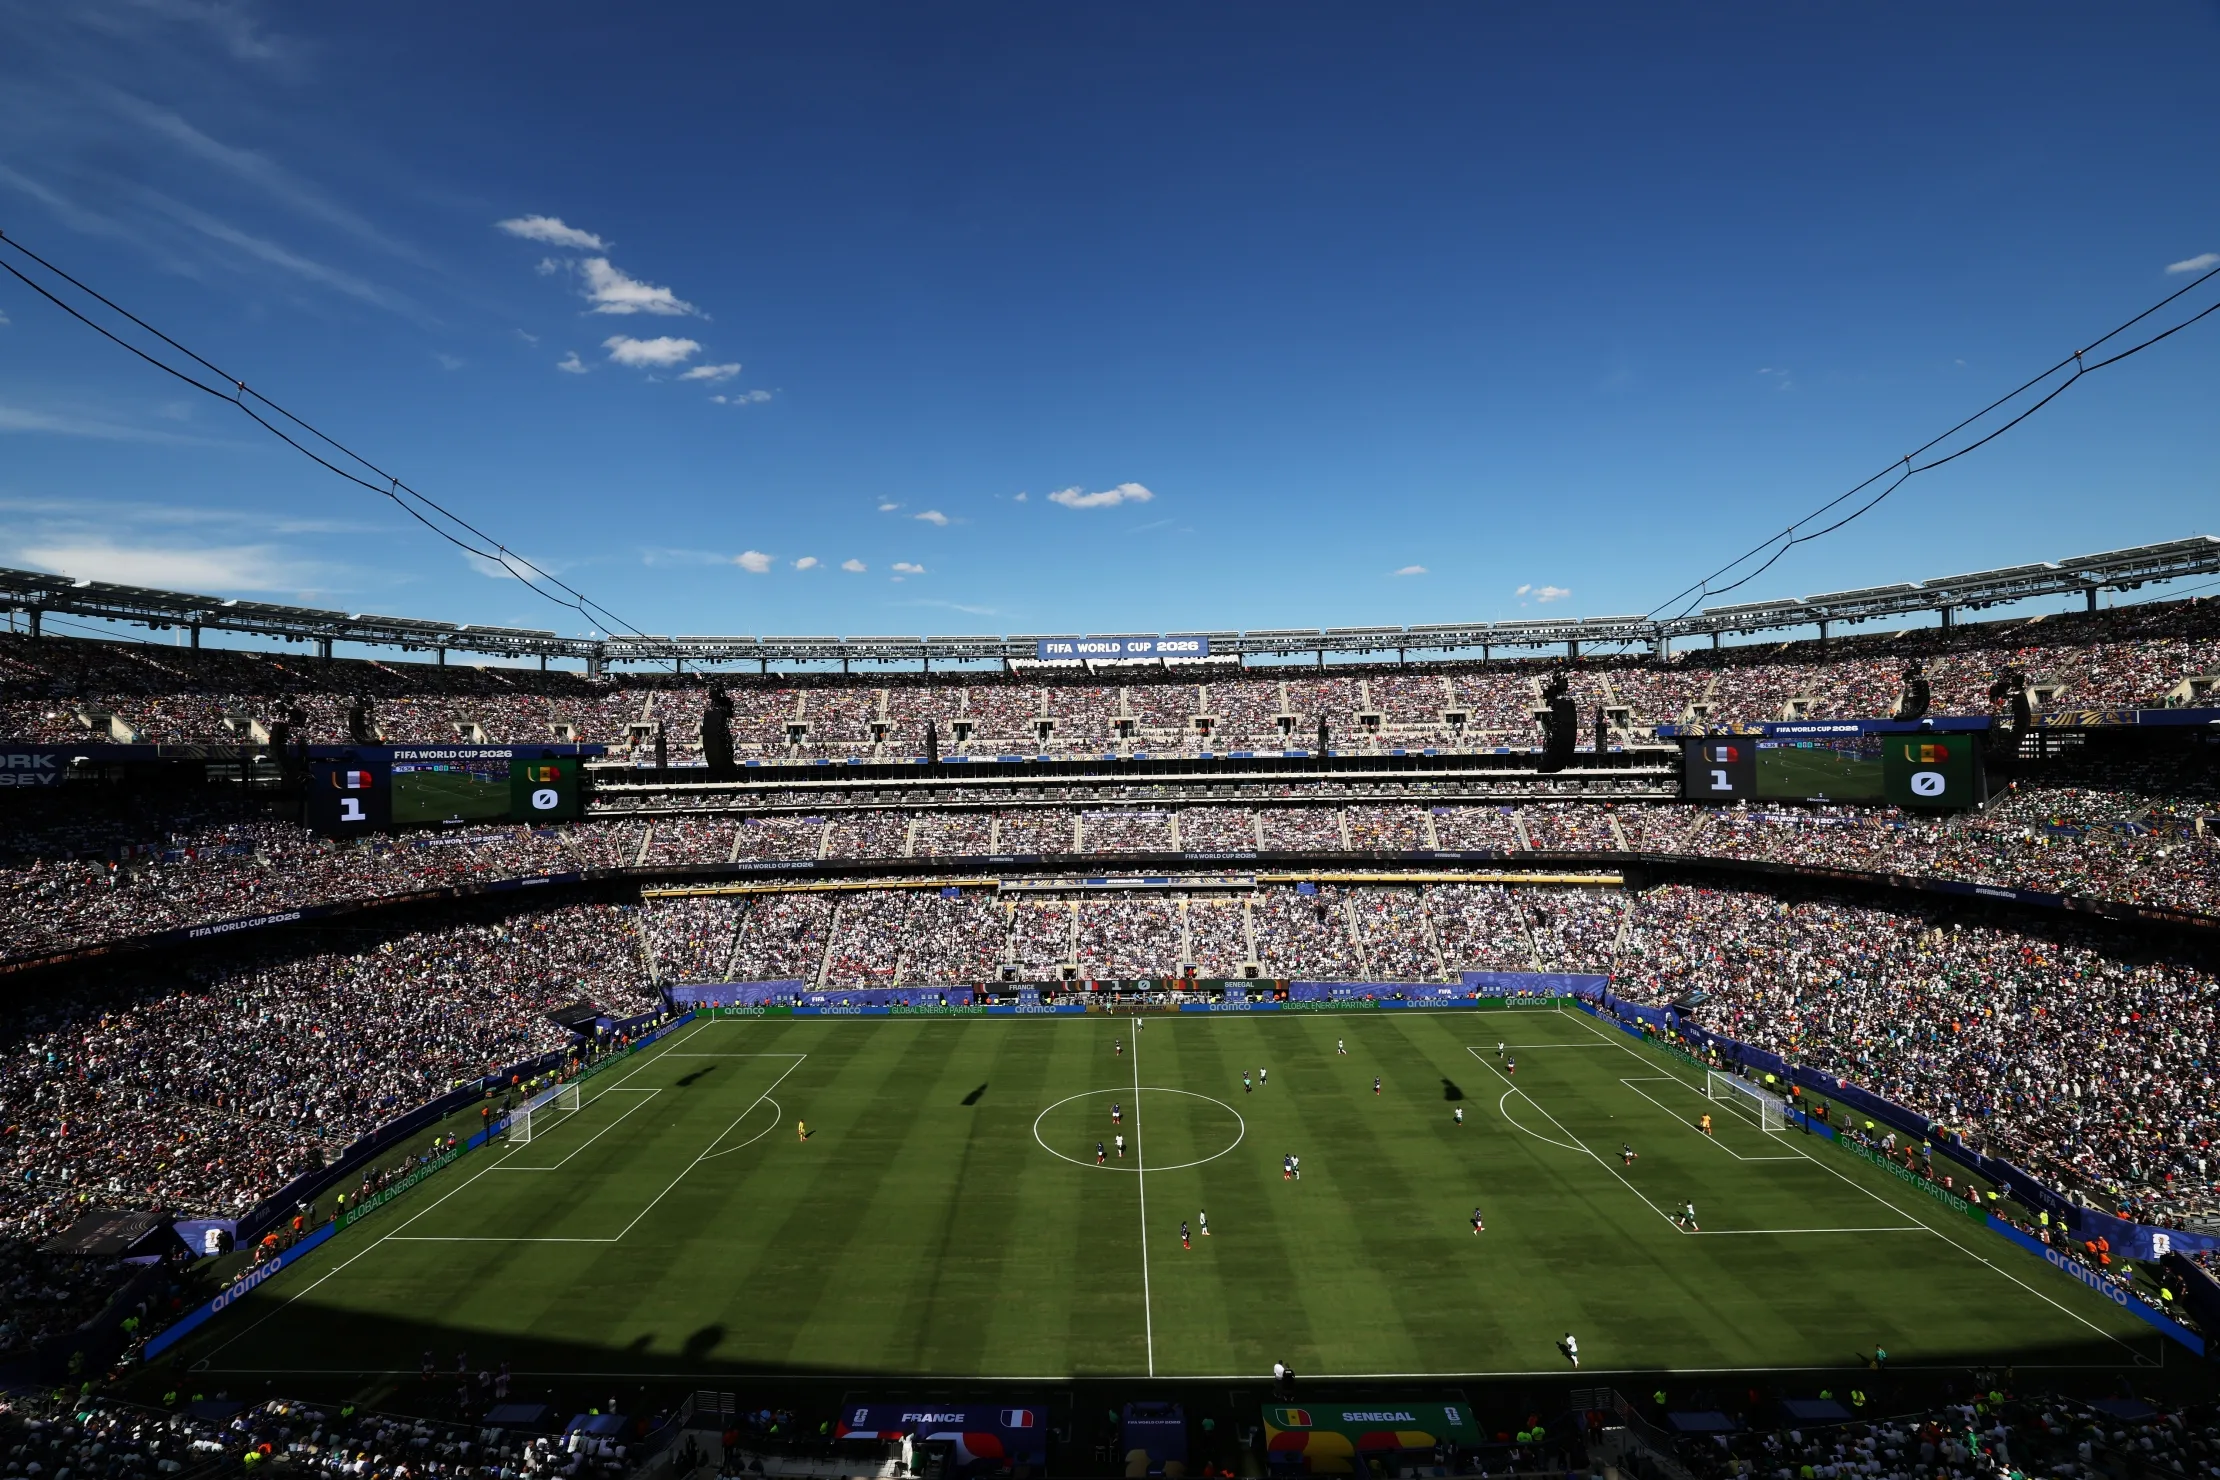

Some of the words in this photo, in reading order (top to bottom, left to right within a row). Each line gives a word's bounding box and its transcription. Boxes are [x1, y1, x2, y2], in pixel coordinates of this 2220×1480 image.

[1047, 644, 1072, 653] FIFA
[1077, 643, 1120, 653] WORLD
[1127, 642, 1152, 652] CUP
[1157, 641, 1199, 651] 2026
[0, 754, 56, 768] RK
[394, 751, 417, 759] FIFA
[420, 750, 456, 758] WORLD
[458, 750, 478, 758] CUP
[480, 750, 512, 758] 2026
[1711, 770, 1732, 790] 1
[1911, 772, 1945, 796] 0
[532, 789, 558, 810] 0
[341, 798, 366, 822] 1
[1976, 888, 2016, 899] #FIFAWorldCup
[190, 928, 212, 938] FIFA
[212, 920, 247, 934] WORLD
[248, 917, 267, 927] CUP
[268, 912, 301, 924] 2026
[1112, 982, 1122, 990] 1
[1138, 980, 1150, 990] 0
[1210, 1003, 1250, 1011] aramco
[1341, 1001, 1374, 1009] PARTNER
[1407, 999, 1448, 1008] aramco
[1506, 997, 1548, 1006] aramco
[724, 1007, 765, 1015] aramco
[820, 1006, 861, 1014] aramco
[1015, 1005, 1056, 1014] aramco
[1596, 1010, 1620, 1028] aramco
[656, 1020, 678, 1039] aramco
[1690, 1028, 1700, 1037] FIFA
[544, 1054, 556, 1063] FIFA
[588, 1060, 608, 1077] ENERGY
[608, 1048, 630, 1065] PARTNER
[1754, 1090, 1794, 1118] aramco
[1841, 1136, 1876, 1165] GLOBAL
[1877, 1154, 1916, 1184] ENERGY
[1918, 1178, 1968, 1214] PARTNER
[346, 1196, 384, 1224] GLOBAL
[384, 1172, 420, 1202] ENERGY
[421, 1148, 458, 1177] PARTNER
[2040, 1191, 2056, 1208] FIFA
[256, 1206, 270, 1222] FIFA
[2046, 1248, 2128, 1306] aramco
[212, 1257, 282, 1312] aramco
[901, 1413, 965, 1423] FRANCE
[1342, 1412, 1416, 1422] SENEGAL
